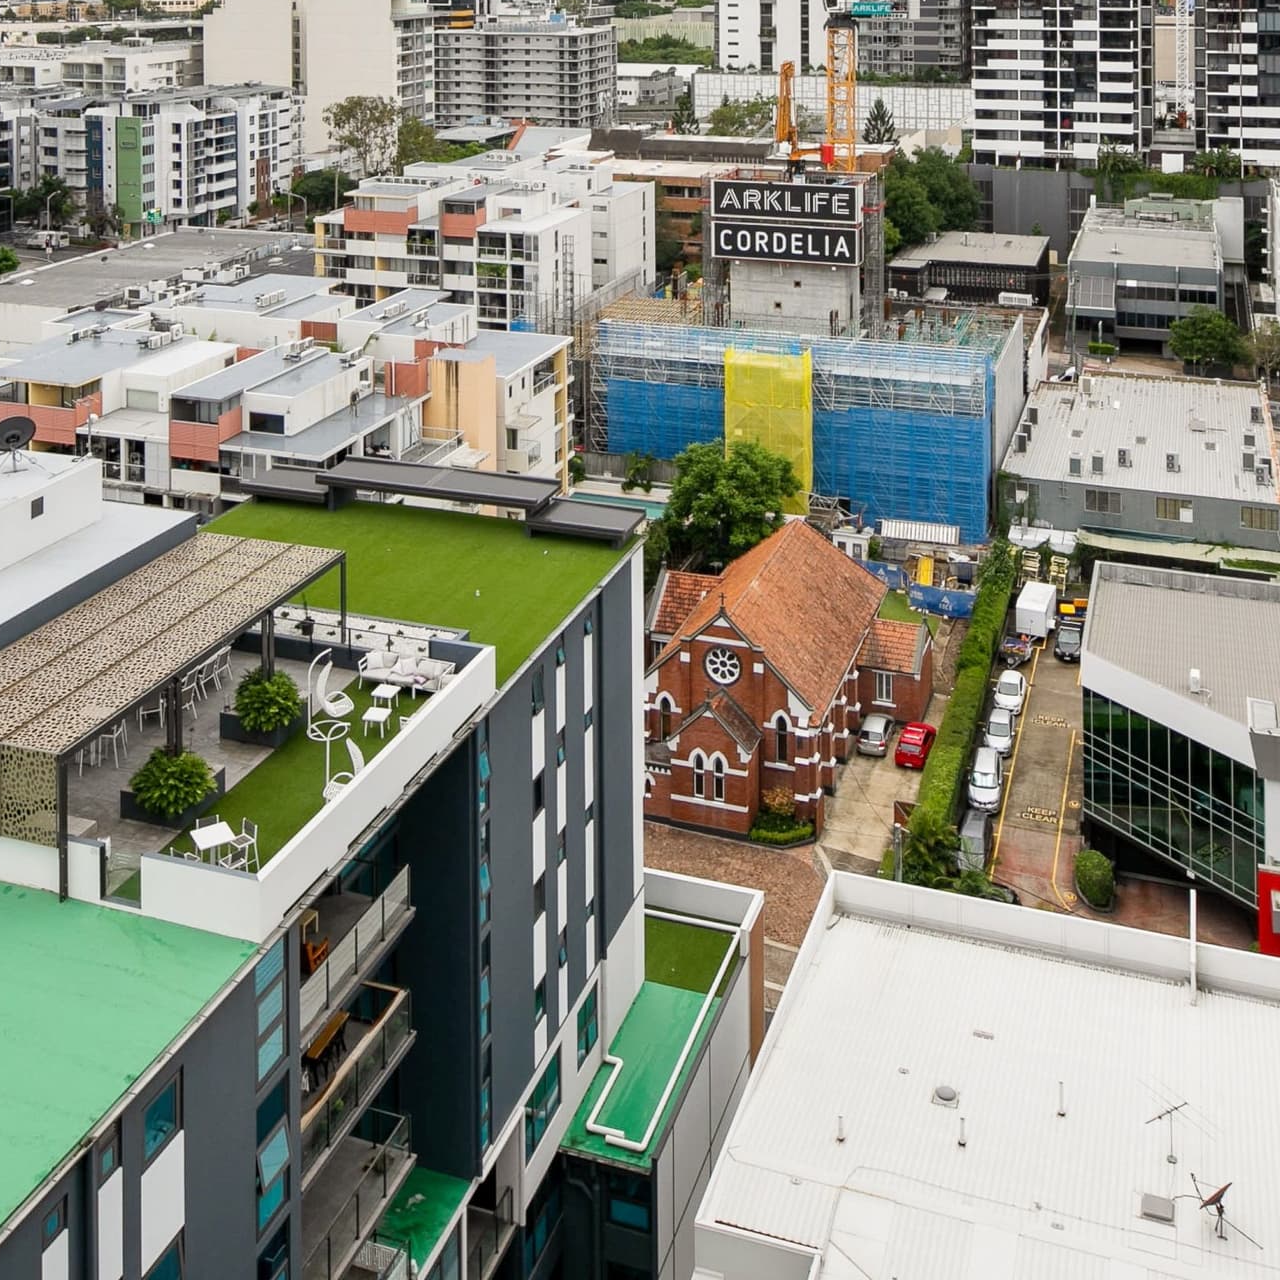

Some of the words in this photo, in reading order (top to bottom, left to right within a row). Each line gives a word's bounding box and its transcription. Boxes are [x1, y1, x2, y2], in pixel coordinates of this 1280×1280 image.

[853, 4, 892, 12] ARKLIFE
[720, 187, 850, 215] ARKLIFE
[720, 229, 850, 258] CORDELIA
[1038, 714, 1065, 723] KEEP
[1027, 806, 1056, 816] KEEP
[1021, 812, 1058, 824] CLEAR
